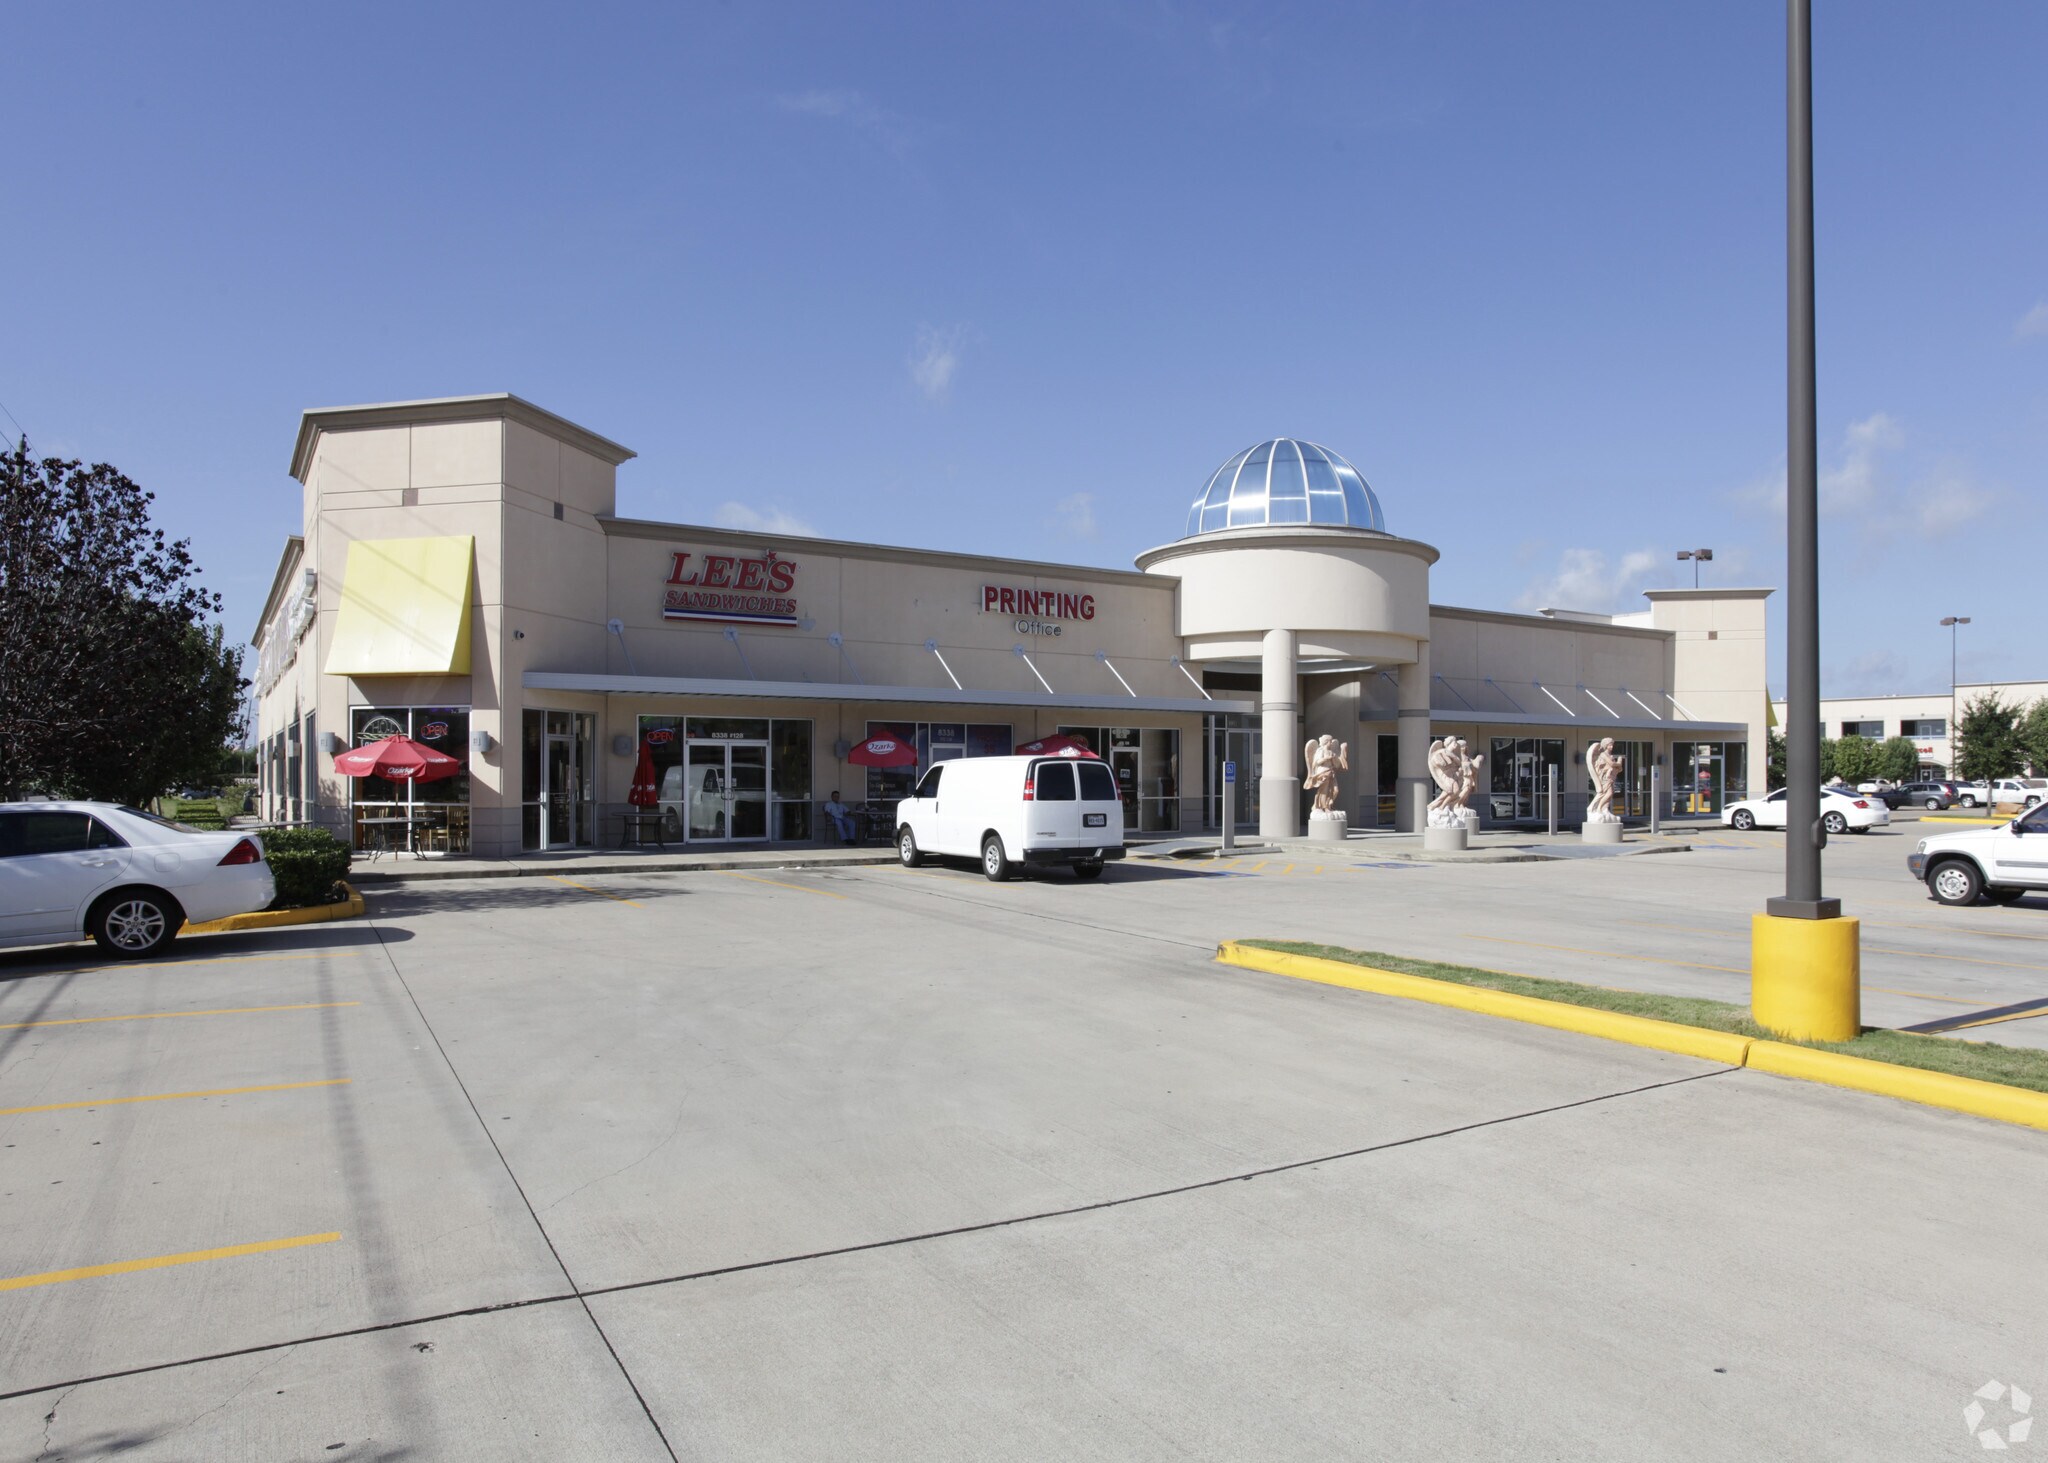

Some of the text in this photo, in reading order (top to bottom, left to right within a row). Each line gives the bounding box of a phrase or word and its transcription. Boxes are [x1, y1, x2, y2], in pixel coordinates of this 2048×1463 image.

[664, 590, 797, 614] SANDWICHES
[982, 586, 1095, 621] PRINTING
[1015, 619, 1062, 637] Office
[420, 724, 448, 737] OPEN
[647, 731, 675, 742] OPEN
[937, 729, 955, 738] 8338
[867, 741, 897, 752] Ozarka
